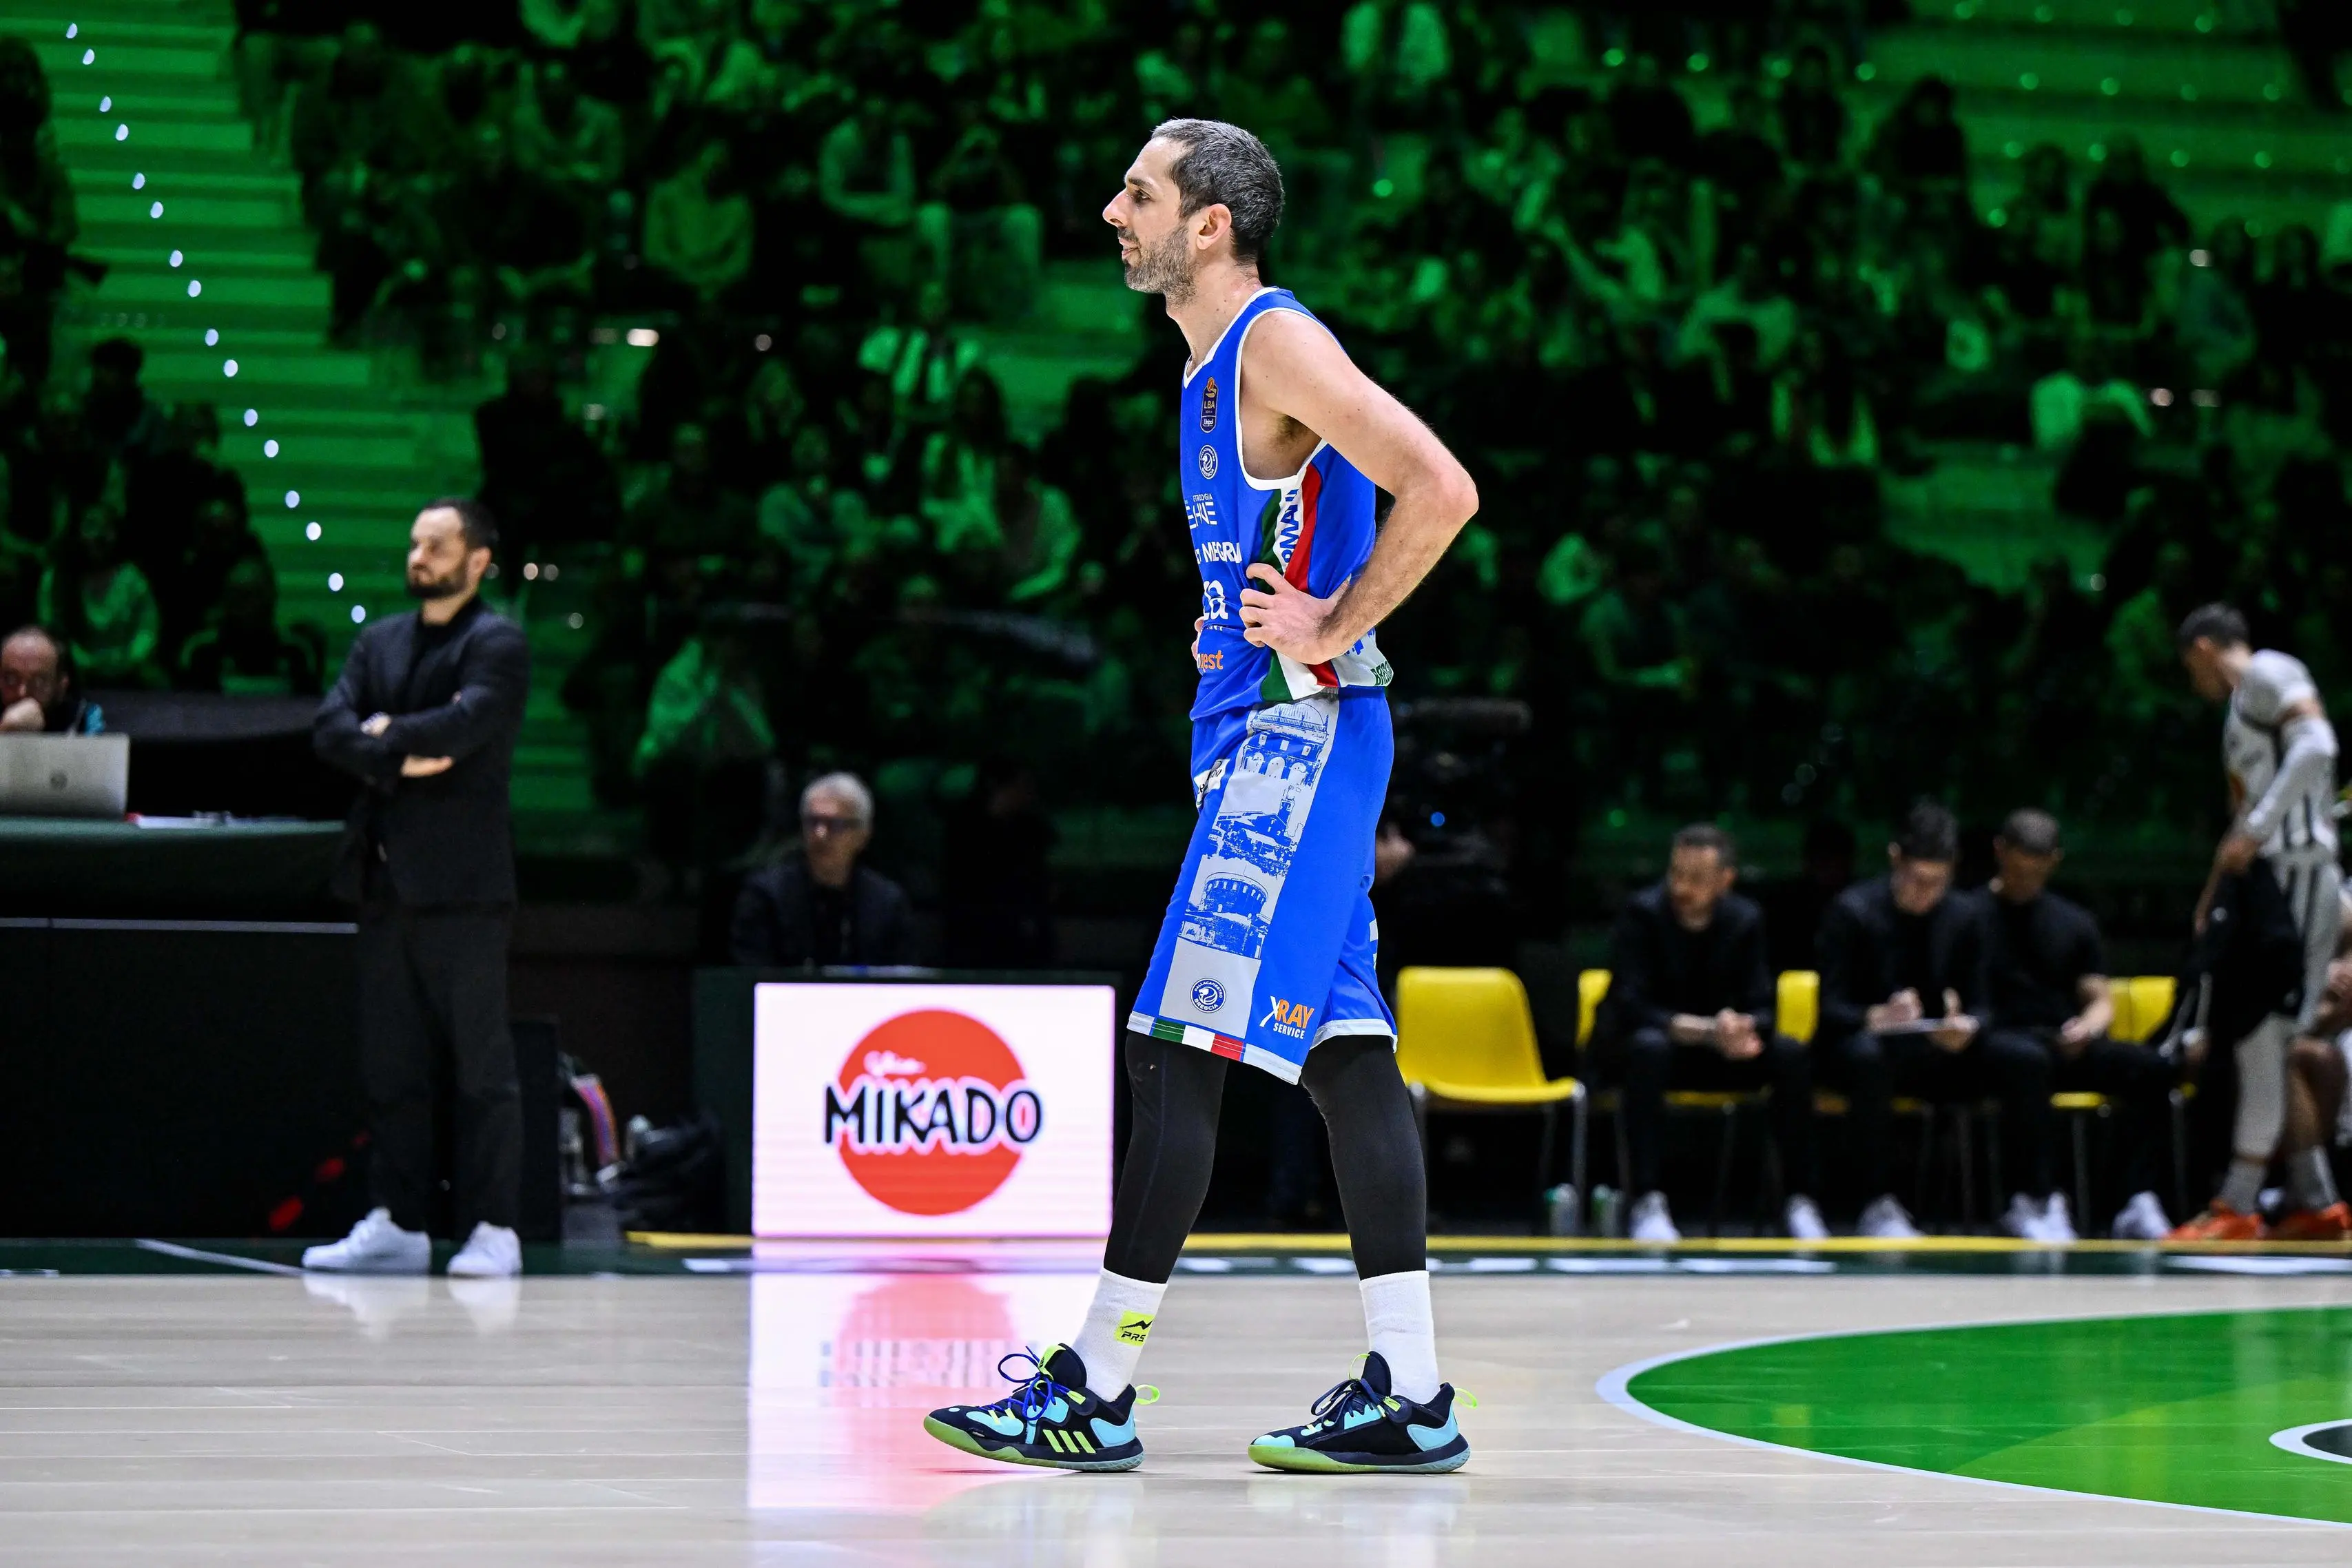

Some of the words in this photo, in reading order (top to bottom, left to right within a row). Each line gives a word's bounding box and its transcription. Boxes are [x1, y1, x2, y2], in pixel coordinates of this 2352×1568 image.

[1204, 400, 1215, 409] LBA
[1194, 981, 1223, 998] PALLACANESTRO
[1194, 998, 1219, 1011] BRESCIA
[1259, 996, 1315, 1029] XRAY
[1272, 1022, 1306, 1040] SERVICE
[825, 1084, 1043, 1145] MIKADO
